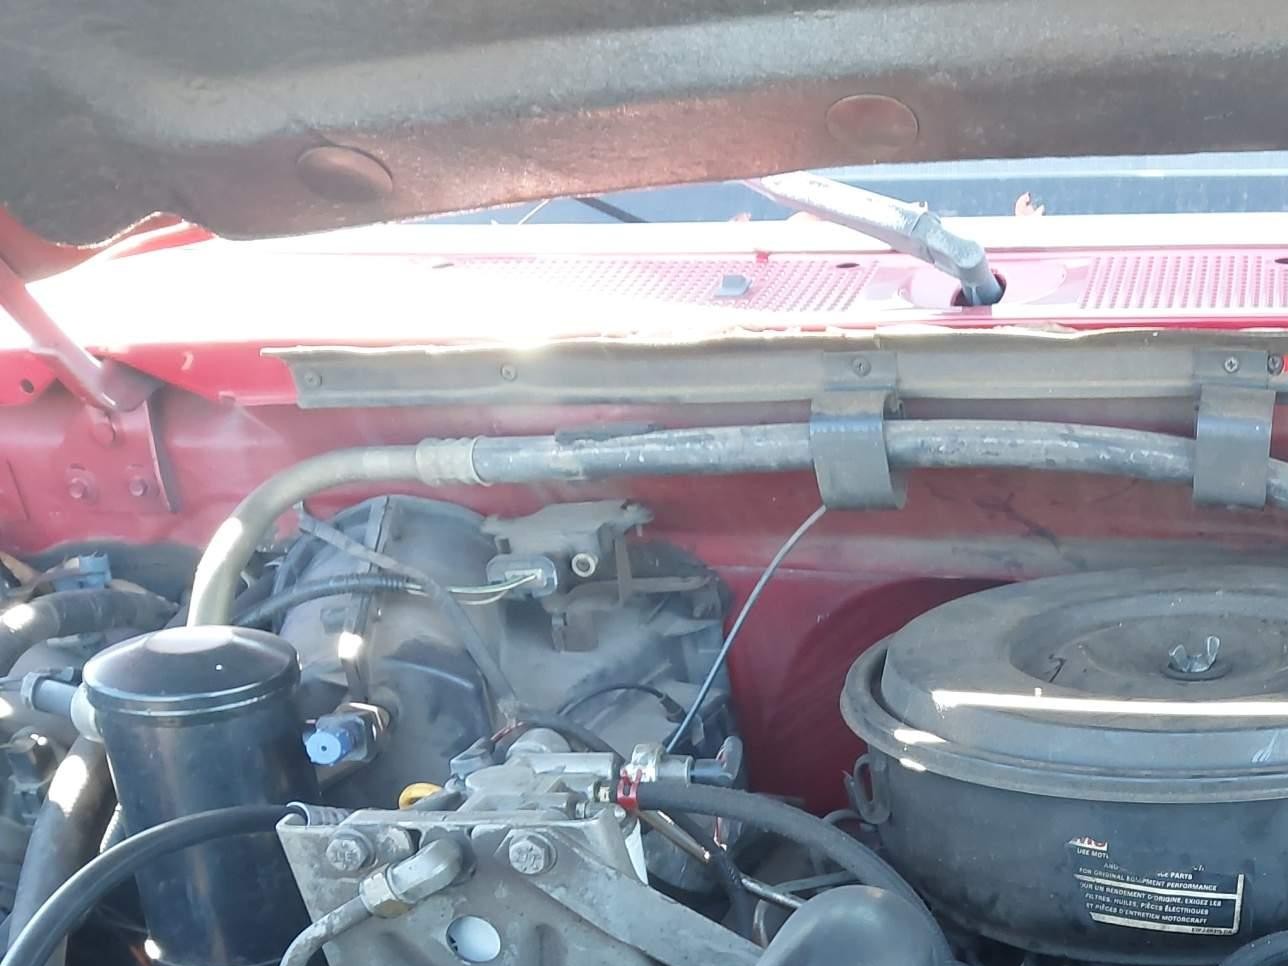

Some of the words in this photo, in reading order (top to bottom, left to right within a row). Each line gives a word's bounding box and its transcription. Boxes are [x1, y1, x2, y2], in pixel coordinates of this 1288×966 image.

[1094, 870, 1125, 881] ORIGINAL
[1166, 881, 1217, 891] PERFORMANCE
[1184, 898, 1209, 906] EXIGEZ
[1164, 904, 1209, 915] ÉLECTRIQUES
[1161, 915, 1208, 925] MOTORCRAFT
